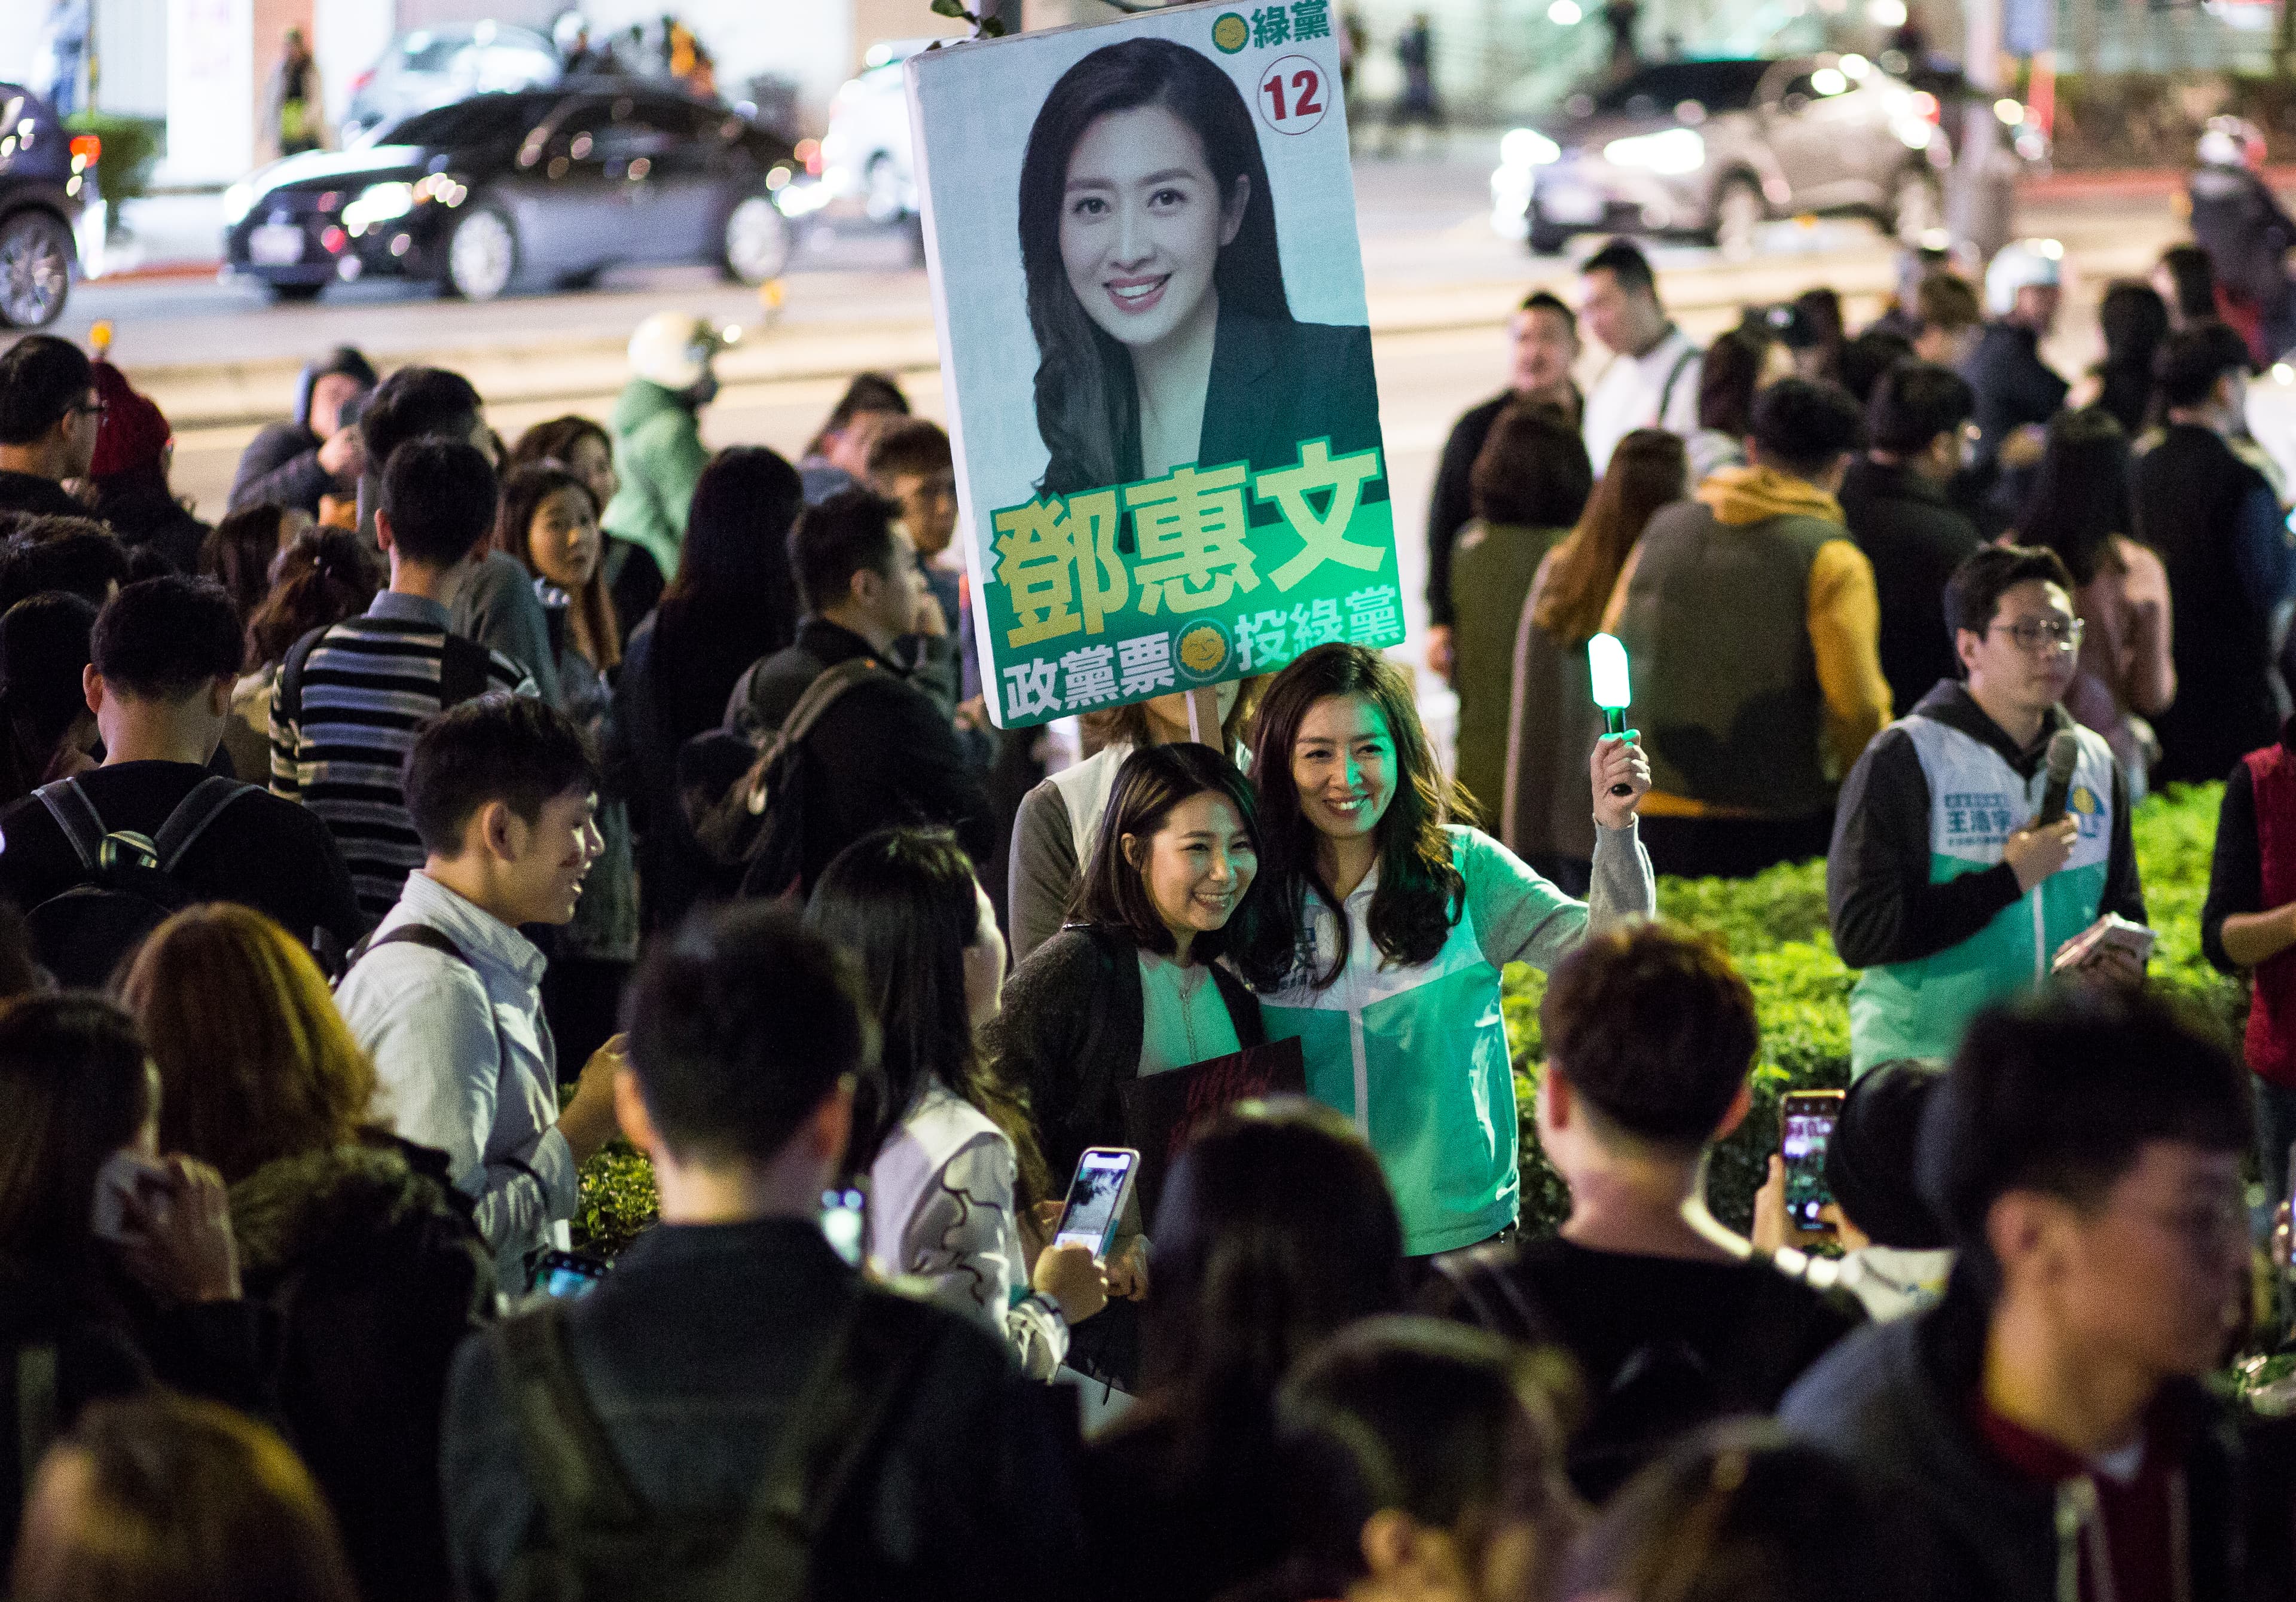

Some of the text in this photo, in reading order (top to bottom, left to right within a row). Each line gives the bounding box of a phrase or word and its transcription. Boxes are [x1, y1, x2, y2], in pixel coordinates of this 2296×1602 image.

[1250, 0, 1330, 48] 綠黨
[1263, 70, 1322, 121] 12
[996, 441, 1387, 649] 鄧惠文
[1003, 585, 1400, 720] 政黨票 投綠黨
